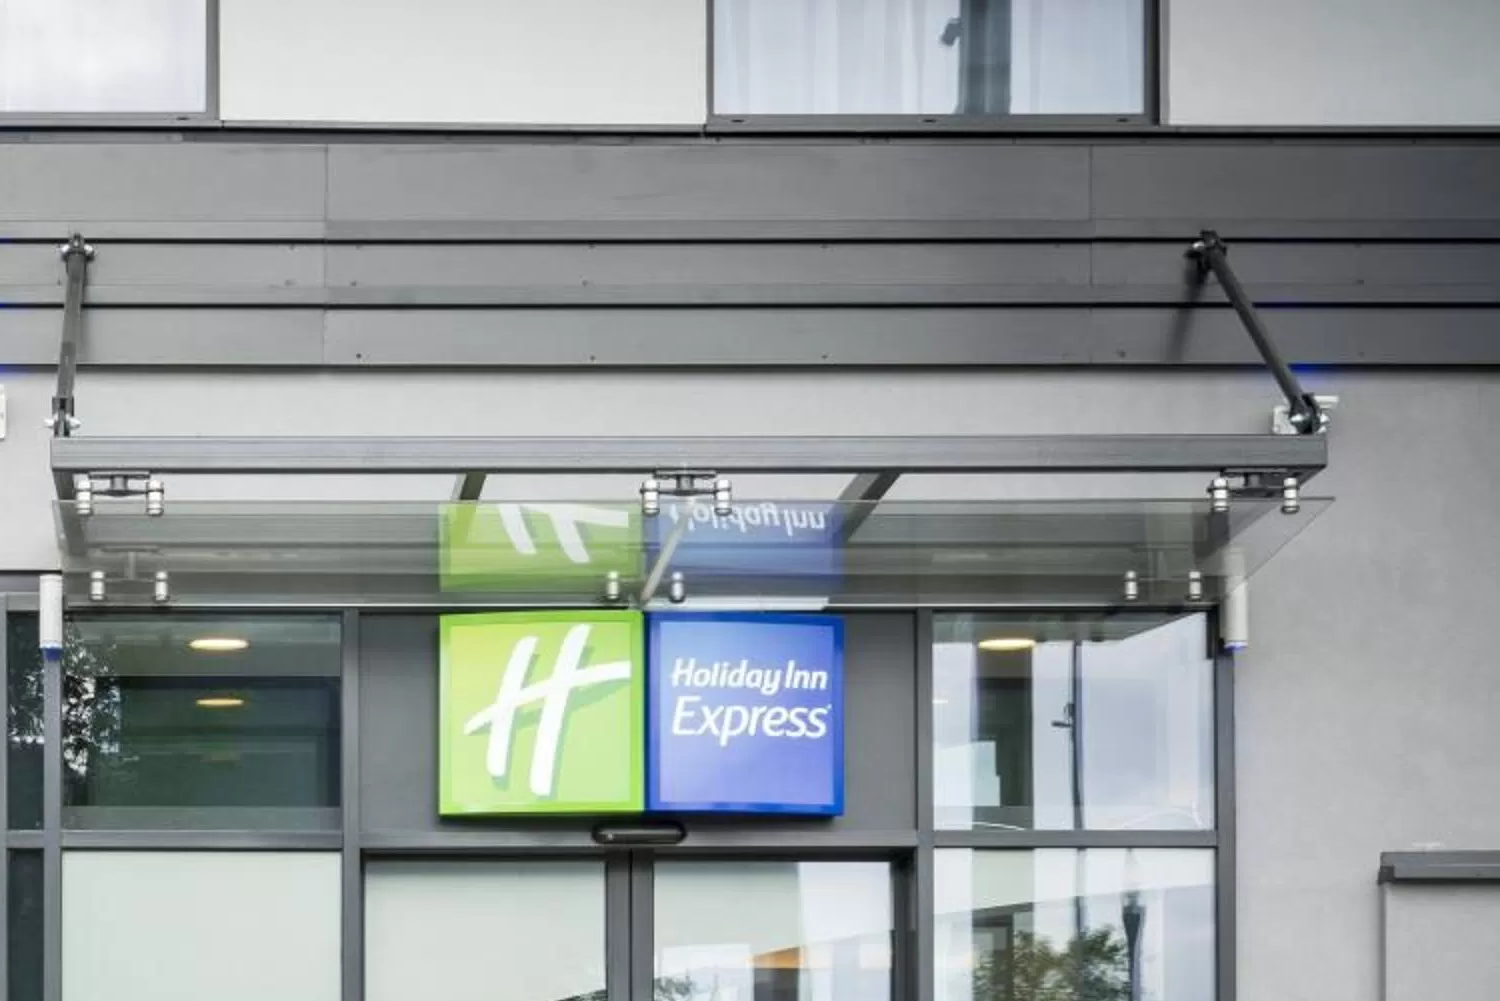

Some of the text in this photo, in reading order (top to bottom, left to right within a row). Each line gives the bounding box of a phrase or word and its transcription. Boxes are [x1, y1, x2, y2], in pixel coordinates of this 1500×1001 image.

[671, 657, 829, 696] Holiday Inn
[463, 623, 631, 797] H
[671, 694, 831, 748] Express
